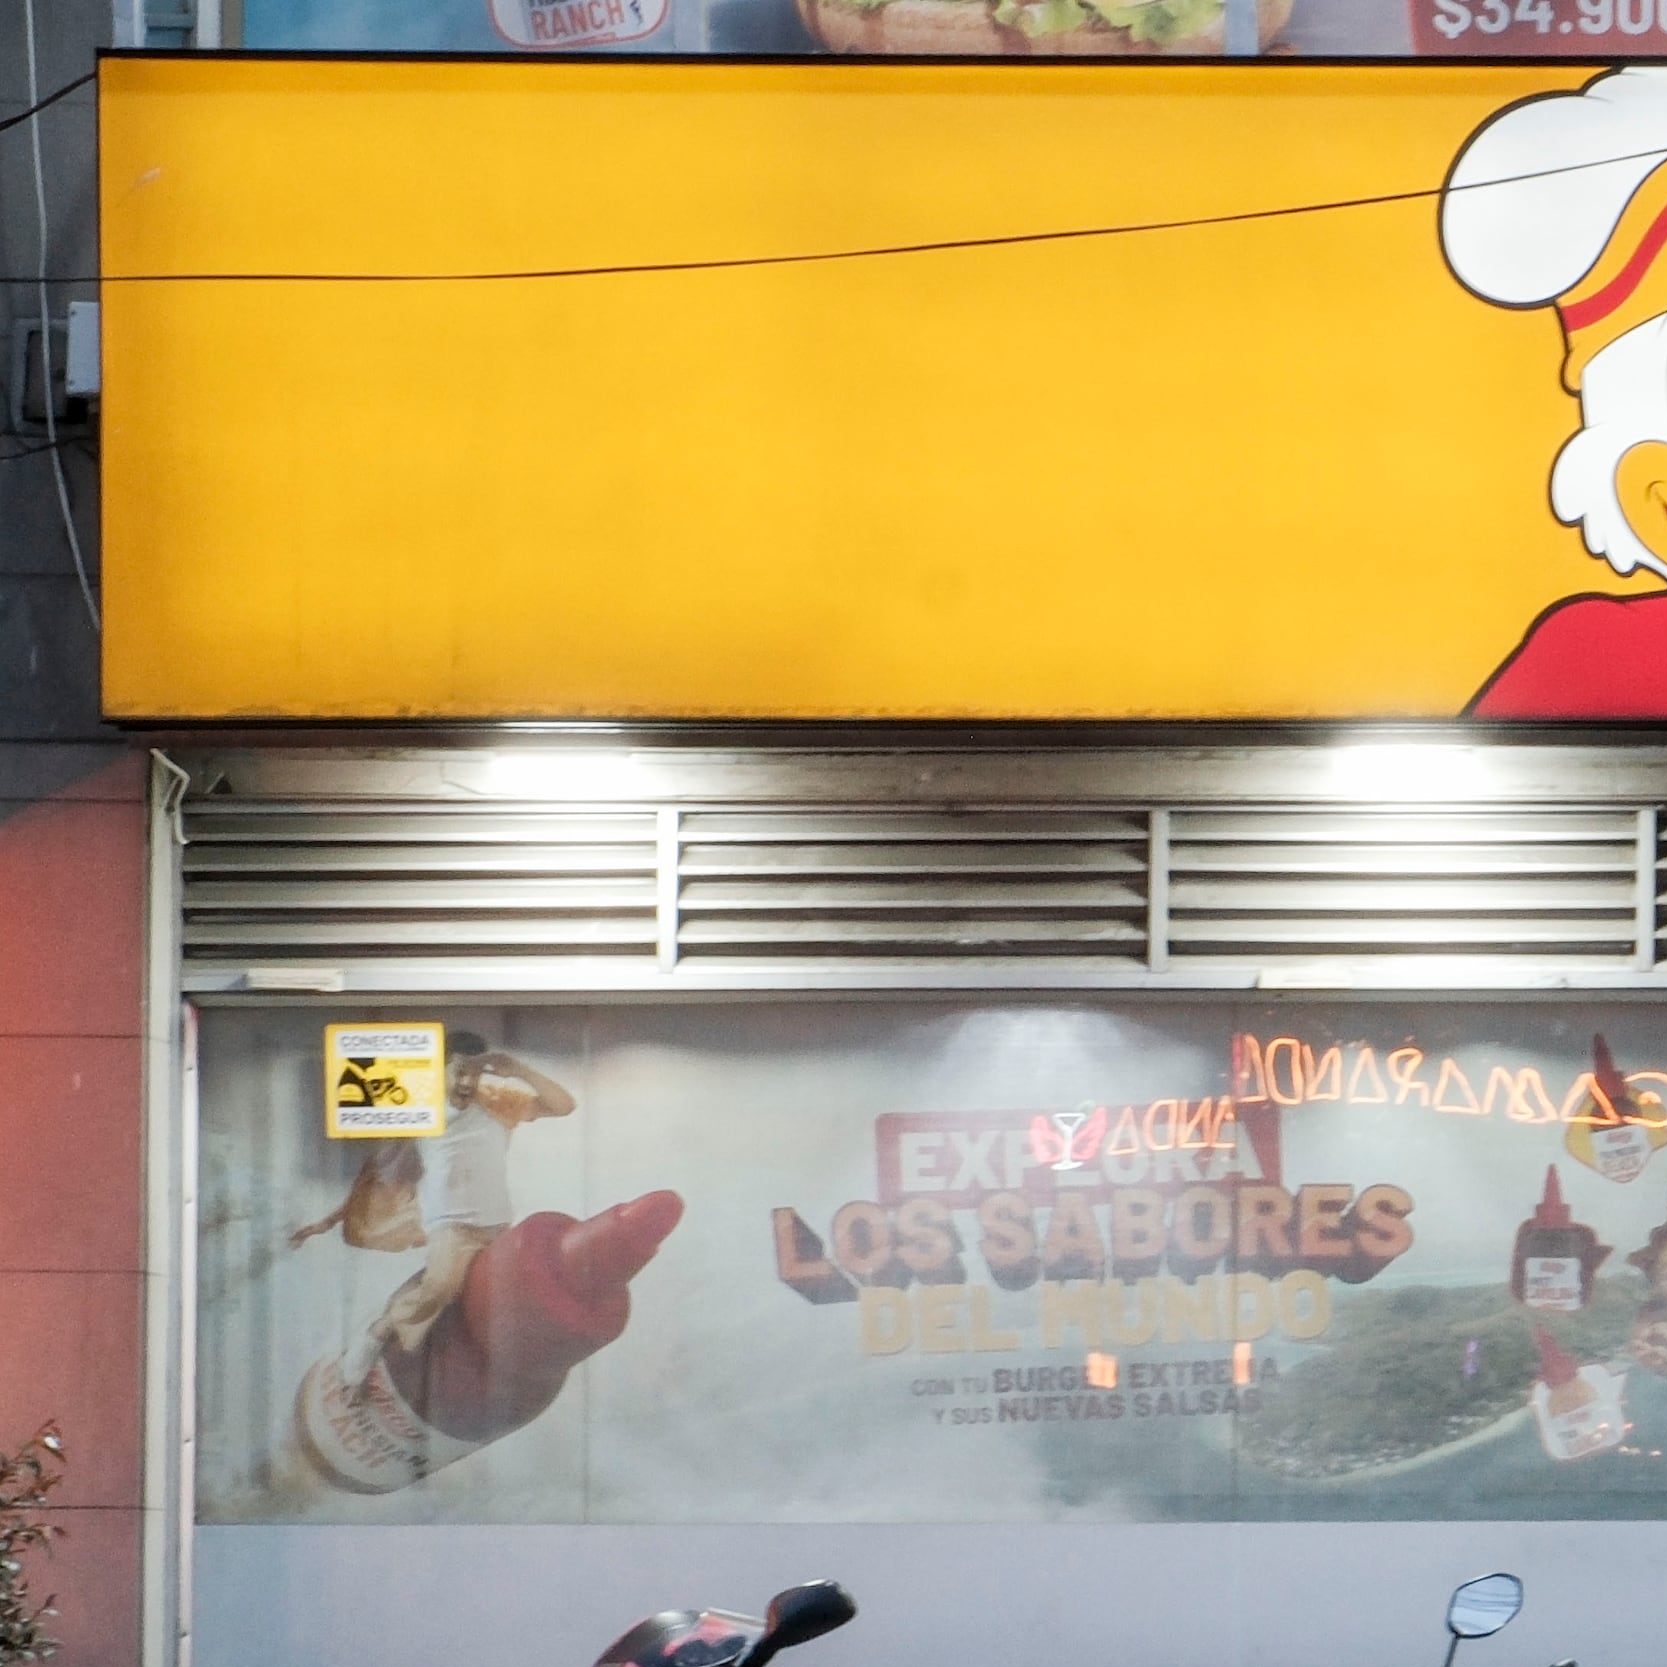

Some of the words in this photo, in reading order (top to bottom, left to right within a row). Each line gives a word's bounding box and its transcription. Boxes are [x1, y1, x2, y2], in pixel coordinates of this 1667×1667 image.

[530, 0, 624, 41] RANCH
[340, 1034, 430, 1048] CONECTADA
[340, 1111, 433, 1125] PROSEGUR
[772, 1199, 962, 1290] LOS
[977, 1184, 1415, 1275] SABORES
[859, 1283, 1024, 1356] DEL
[1039, 1269, 1332, 1349] MUNDO
[911, 1377, 955, 1397] CON
[993, 1364, 1118, 1393] BURG
[1128, 1356, 1281, 1389] EXTREA
[932, 1408, 946, 1425] Y
[951, 1406, 992, 1425] SUS
[998, 1392, 1126, 1423] NUEVAS
[1133, 1386, 1264, 1418] SALSAS
